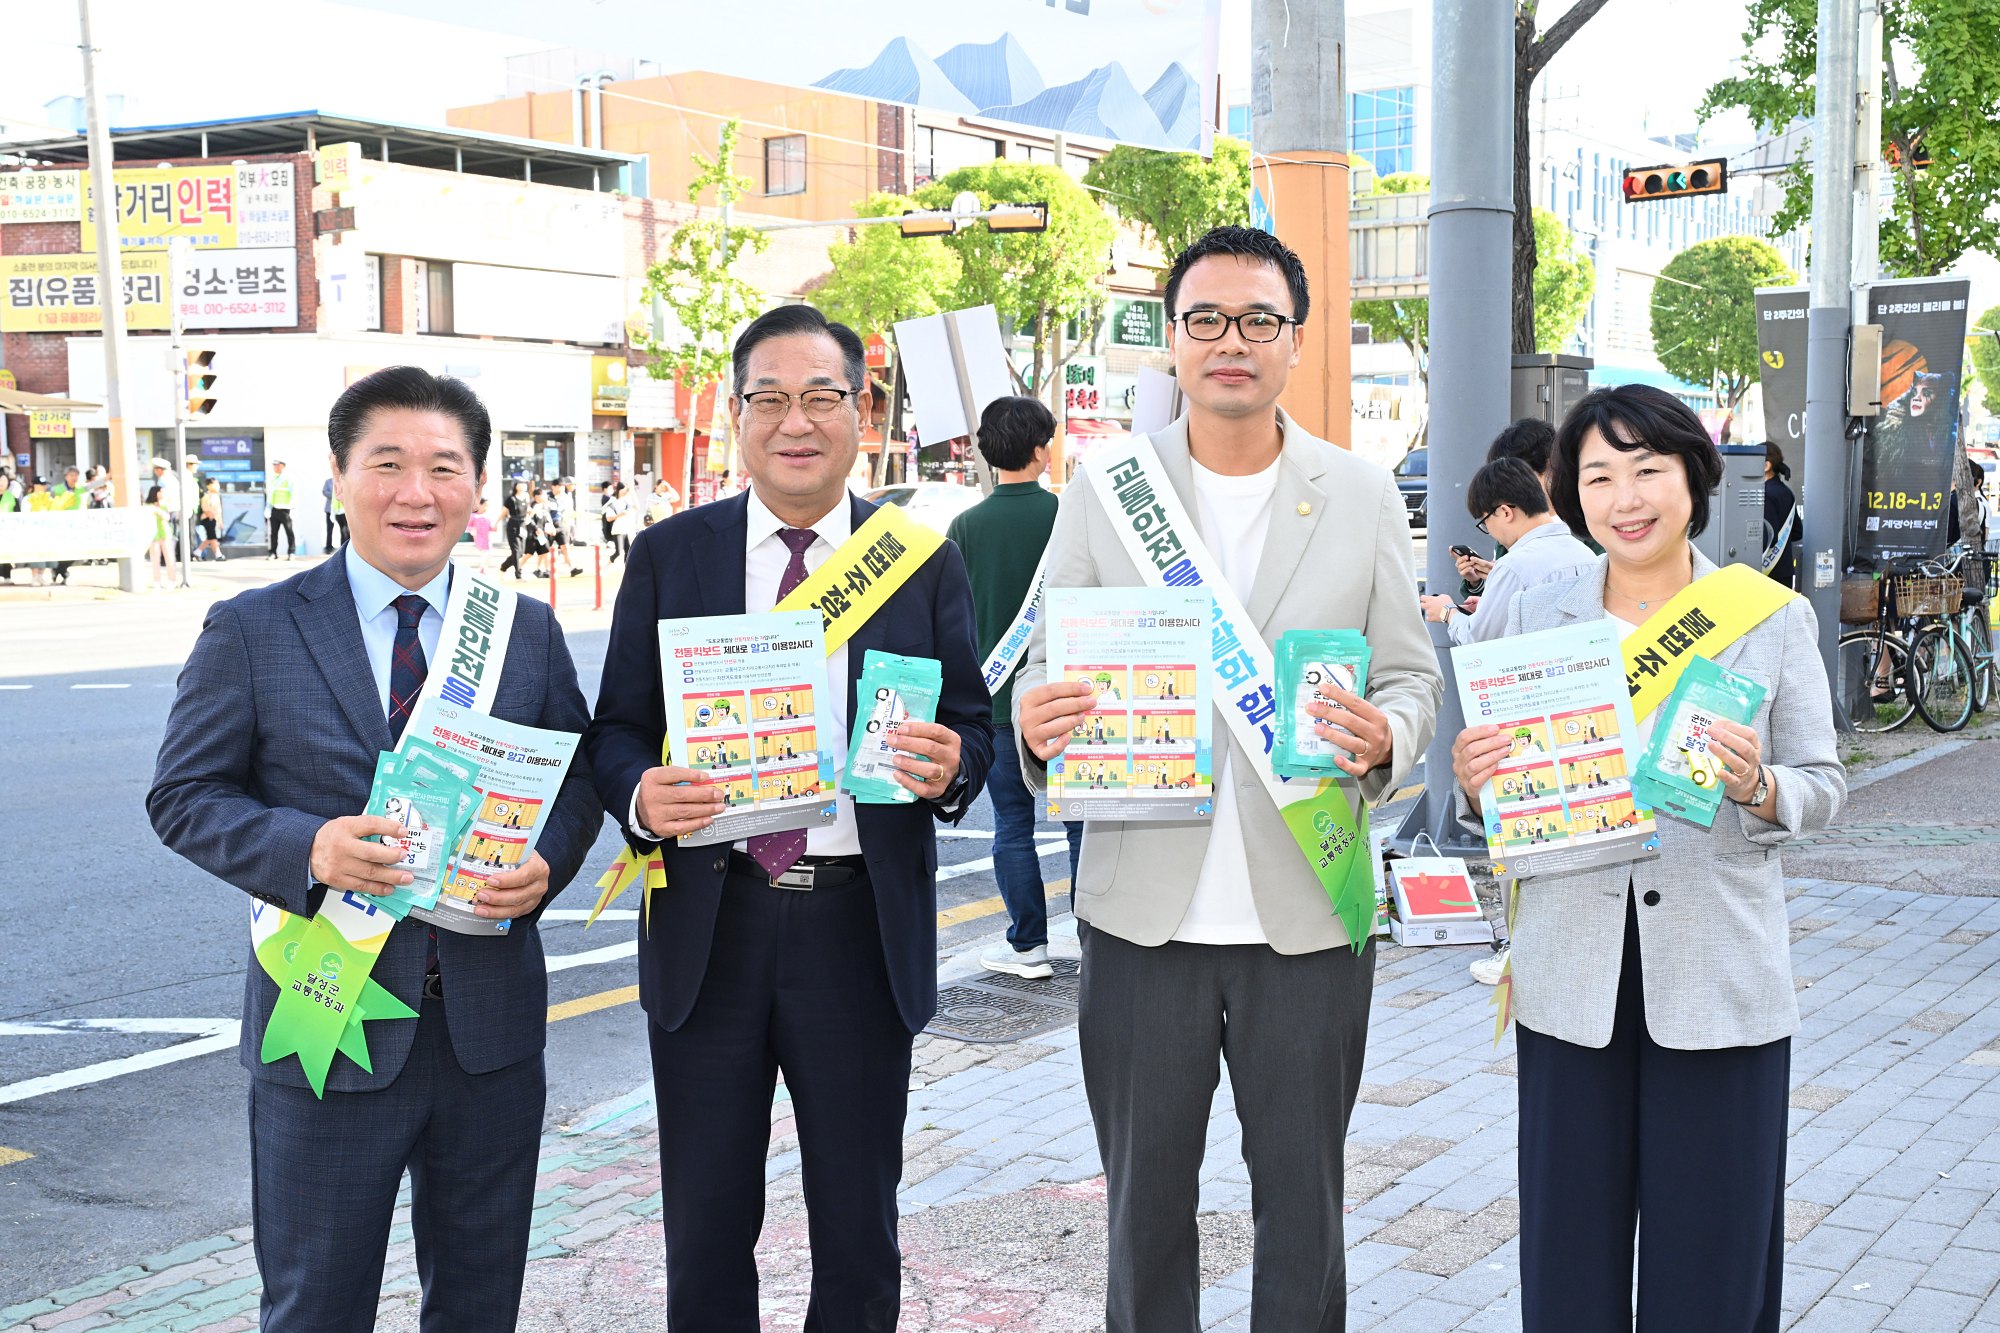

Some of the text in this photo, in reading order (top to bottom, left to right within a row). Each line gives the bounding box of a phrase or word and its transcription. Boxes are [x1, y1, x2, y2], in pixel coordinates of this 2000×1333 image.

[272, 170, 288, 187] 모집
[323, 158, 347, 179] 인력
[26, 176, 46, 189] 공장
[53, 174, 75, 188] 농사
[204, 302, 286, 315] 010-6524-3112
[1764, 309, 1804, 321] 단 2주간의
[1877, 304, 1887, 315] 단
[1889, 303, 1920, 314] 2주간의
[37, 423, 67, 435] 인력
[1867, 491, 1942, 510] 12.18~1.3
[1881, 519, 1938, 530] 계명아트센터
[861, 531, 907, 579] 불법
[1110, 618, 1135, 628] 제대로
[1137, 617, 1157, 628] 알고
[1158, 617, 1201, 628] 이용합시다
[1656, 607, 1716, 658] 불법
[674, 640, 814, 659] 전동킥보드 제대로 알고 이용합시다
[998, 622, 1031, 662] 생활화
[1469, 657, 1610, 692] 전동킥보드 제대로 알고 이용합시다
[432, 725, 562, 767] 전동킥보드 제대로 알고 이용합시다
[1319, 826, 1347, 852] 달성군
[1318, 831, 1356, 869] 교통행정과
[306, 972, 340, 996] 달성군
[291, 979, 345, 1014] 교통행정과
